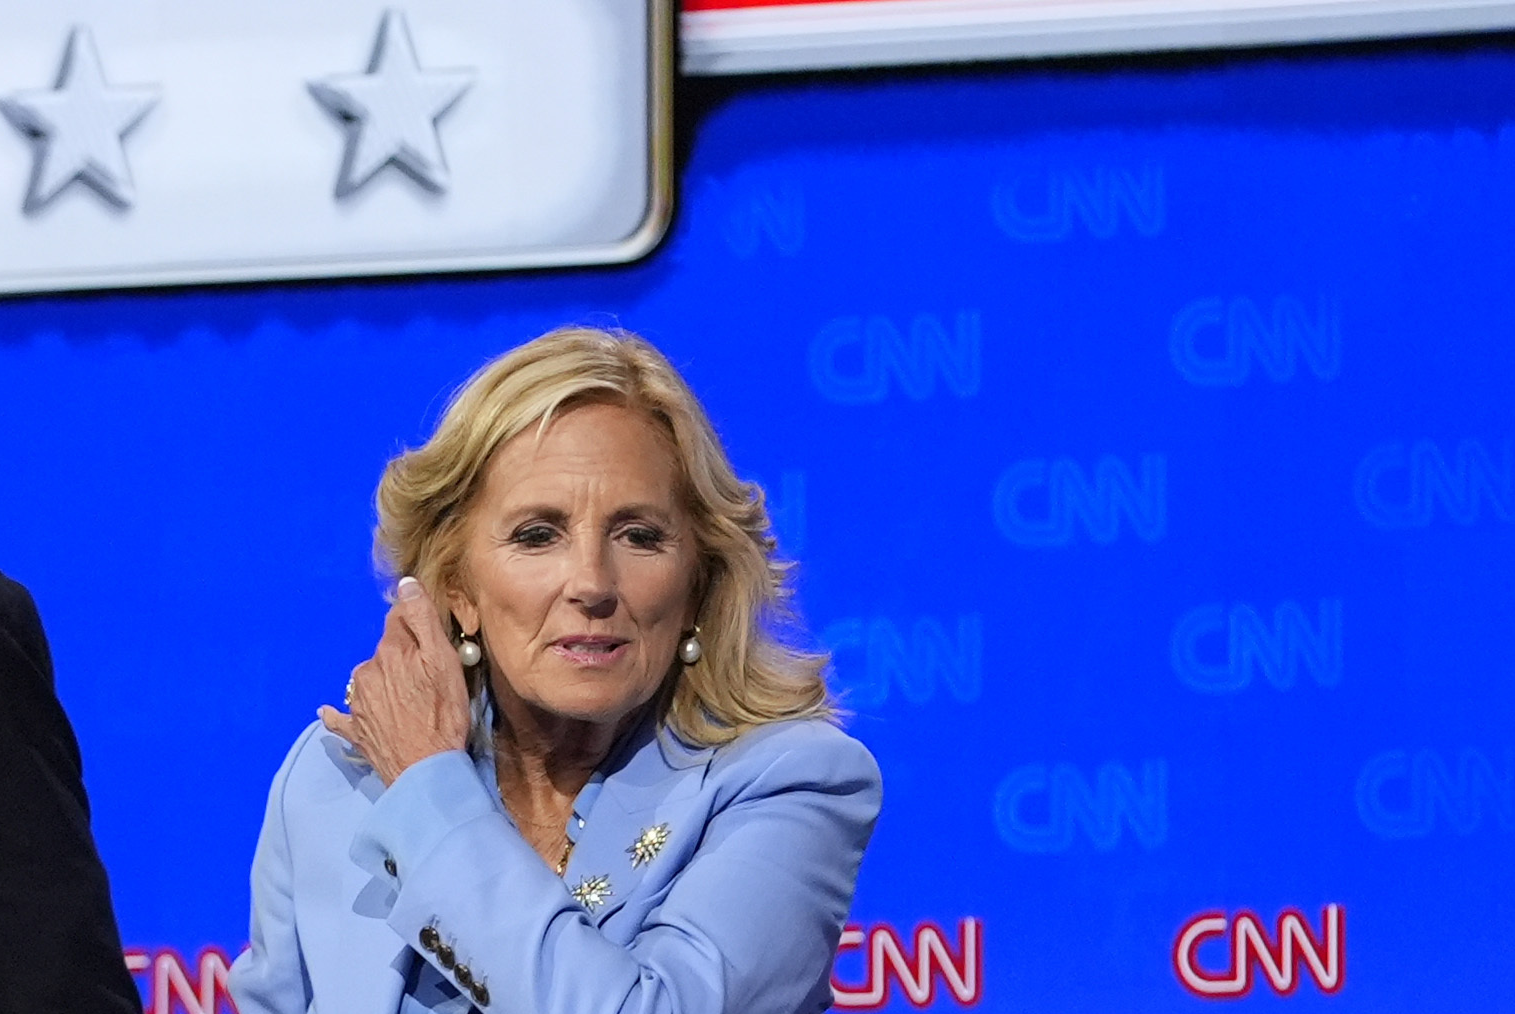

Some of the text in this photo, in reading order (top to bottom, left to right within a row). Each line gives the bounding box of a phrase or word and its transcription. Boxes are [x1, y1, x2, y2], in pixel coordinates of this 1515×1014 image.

[990, 156, 1167, 246] CNN
[807, 309, 983, 405] CNN
[1170, 292, 1343, 388] CNN
[991, 452, 1168, 548] CNN
[1170, 598, 1344, 694] CNN
[991, 757, 1169, 854] CNN
[1176, 904, 1344, 995] CNN
